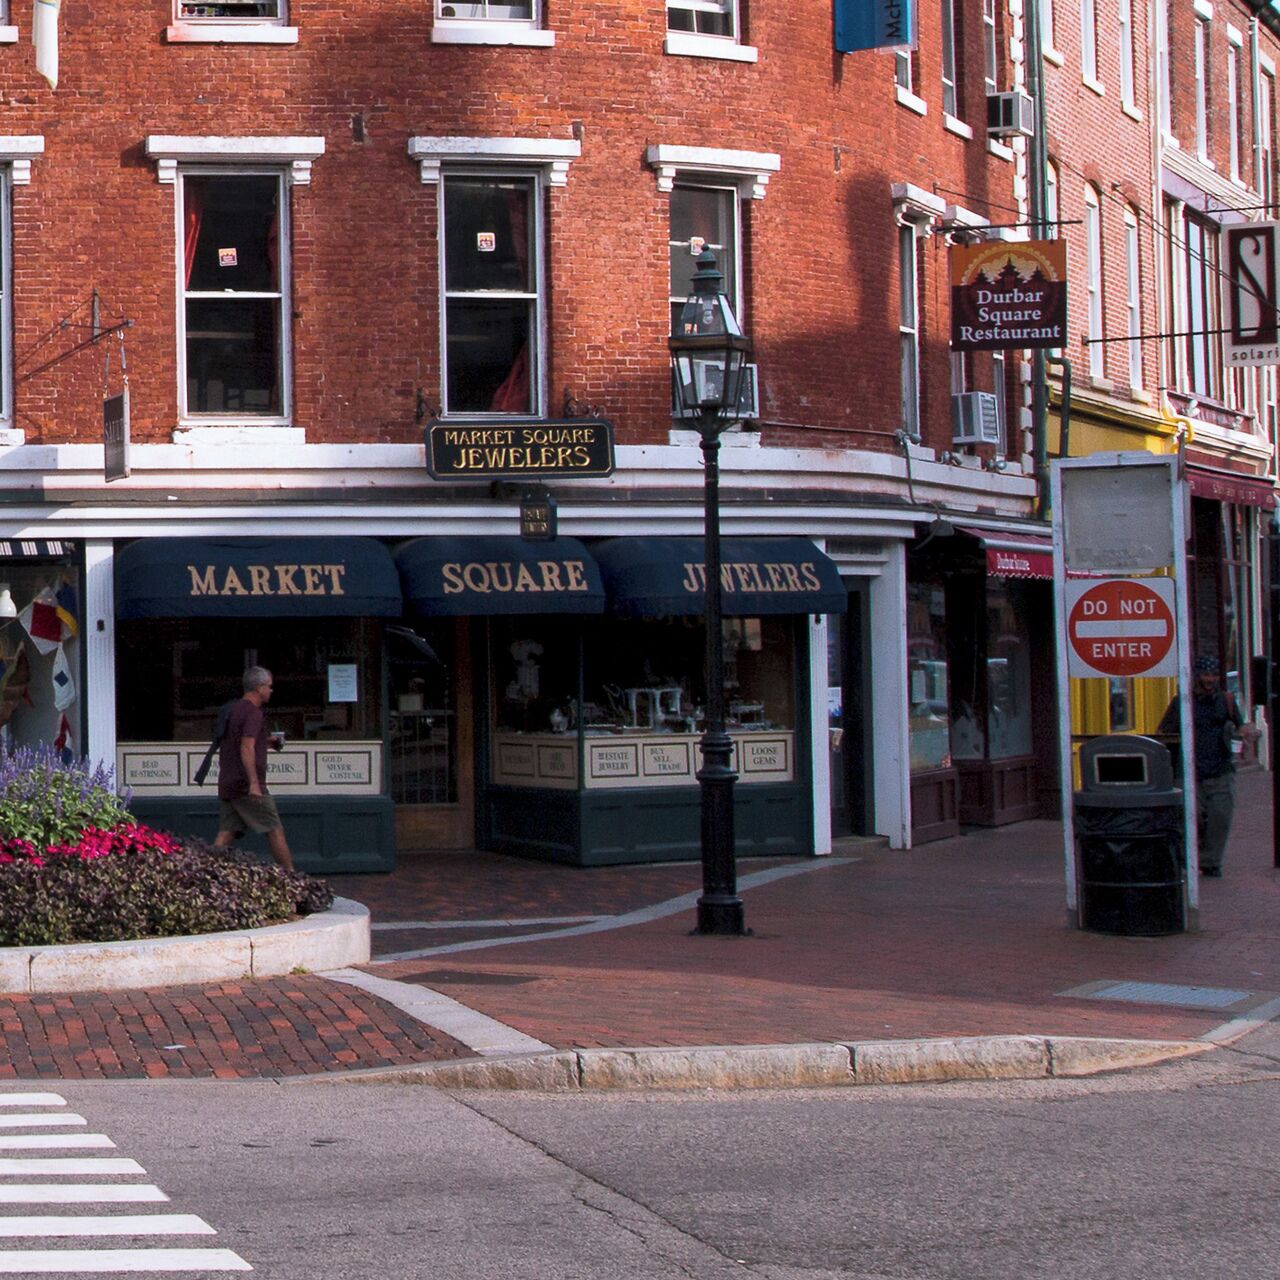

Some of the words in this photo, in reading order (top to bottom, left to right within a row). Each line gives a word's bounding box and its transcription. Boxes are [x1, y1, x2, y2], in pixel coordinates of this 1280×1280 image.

[976, 288, 1044, 305] Durbar
[978, 307, 1042, 326] Square
[960, 325, 1061, 342] Restaurant
[1231, 347, 1279, 361] solari
[444, 430, 516, 446] MARKET
[522, 428, 596, 446] SQUARE
[452, 446, 591, 470] JEWELERS
[187, 564, 346, 596] MARKET
[441, 561, 589, 594] SQUARE
[682, 562, 822, 593] JWELERS
[1083, 600, 1108, 615] DO
[1120, 599, 1157, 614] NOT
[1092, 643, 1152, 658] ENTER
[751, 746, 777, 755] LOOSE
[753, 757, 777, 765] GEMS
